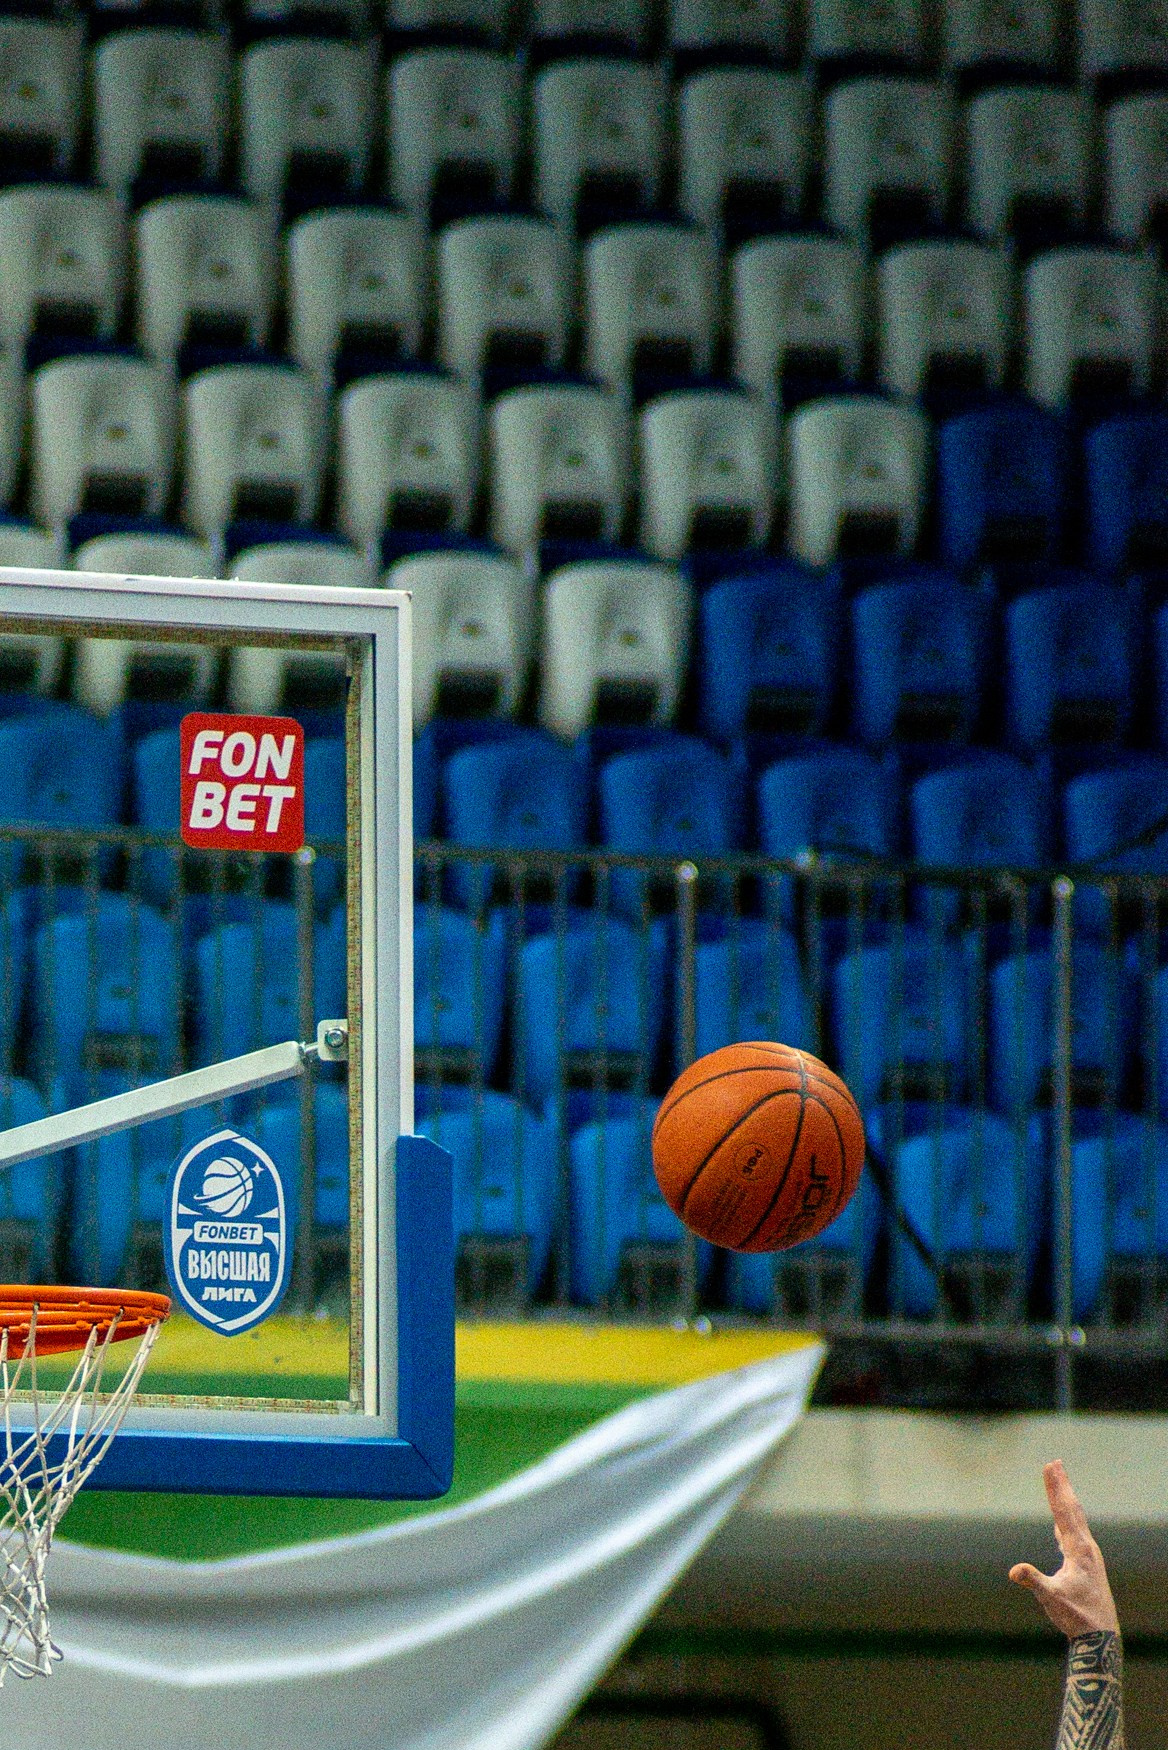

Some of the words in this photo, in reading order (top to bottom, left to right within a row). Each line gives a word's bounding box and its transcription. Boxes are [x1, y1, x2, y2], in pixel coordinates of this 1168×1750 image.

[188, 730, 296, 780] FON
[188, 781, 296, 833] BET
[199, 1225, 258, 1240] FONBET
[188, 1249, 271, 1282] ВЫСШАЯ
[202, 1286, 257, 1302] ЛИГА
